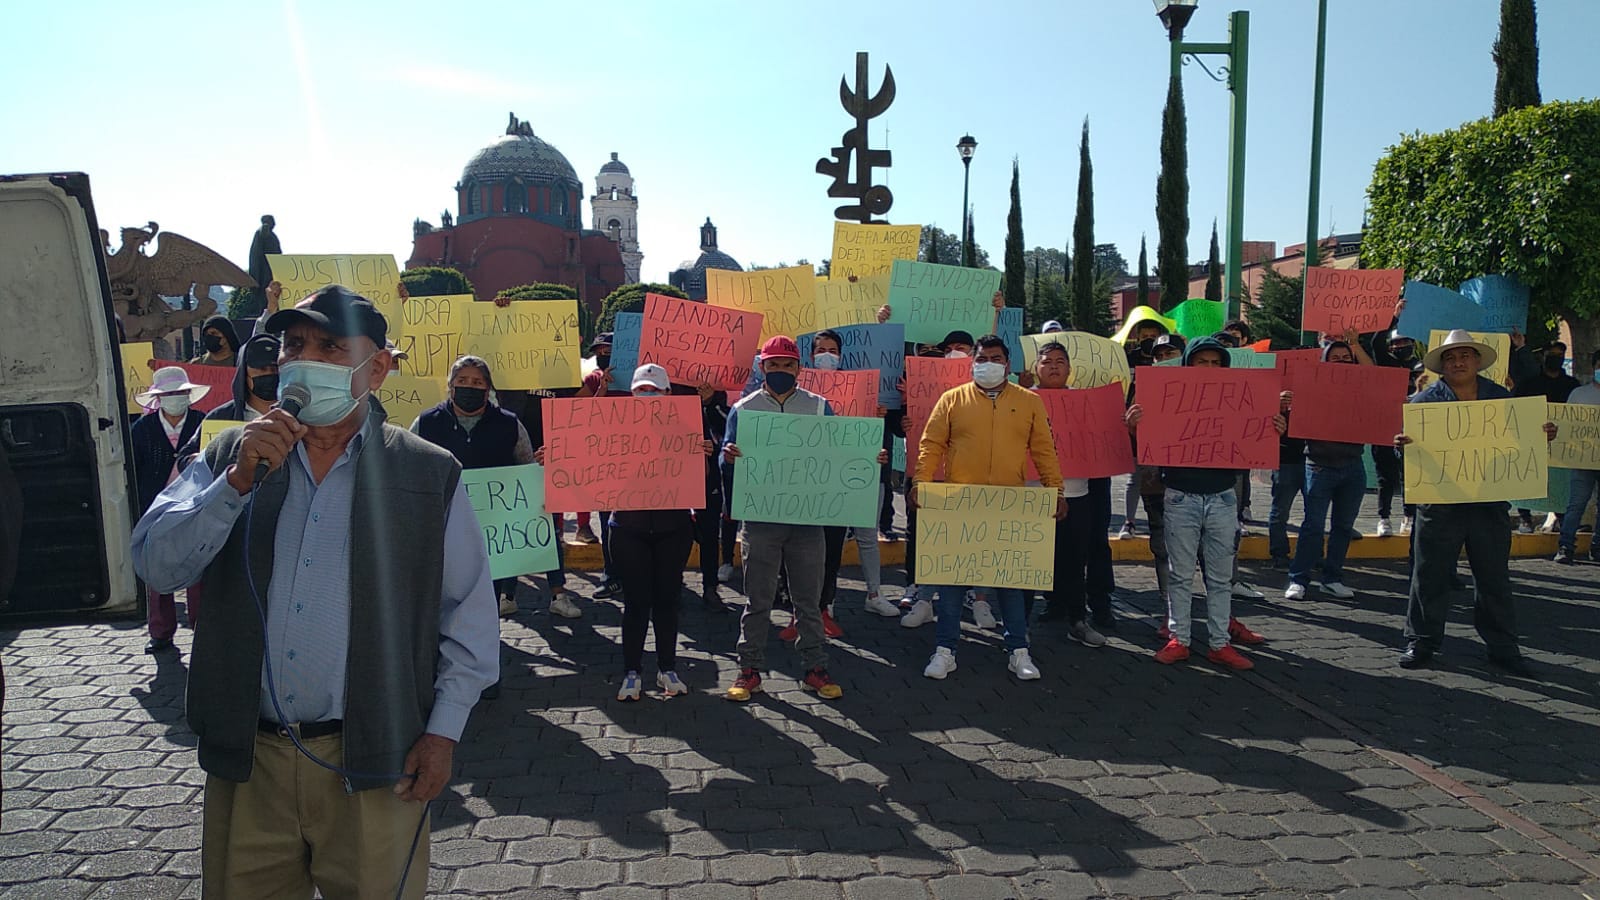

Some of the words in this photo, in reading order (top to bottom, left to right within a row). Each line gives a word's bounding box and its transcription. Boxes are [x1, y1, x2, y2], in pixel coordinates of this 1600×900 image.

[838, 246, 865, 261] DEJA
[289, 256, 393, 286] JUSTICIA
[893, 261, 995, 297] LEANDRA
[1308, 270, 1393, 293] JURIDICOS
[712, 273, 801, 307] FUERA
[1310, 291, 1320, 307] Y
[467, 308, 555, 337] LEANDRA
[648, 296, 744, 336] LEANDRA
[909, 296, 990, 323] RATERA
[654, 327, 736, 358] RESPETA
[1160, 380, 1255, 415] FUERA
[551, 399, 680, 431] LEANDRA
[1179, 416, 1224, 442] LOS
[1242, 415, 1273, 442] DE
[1408, 403, 1520, 442] FUERA
[750, 415, 882, 449] TESORERO
[550, 437, 577, 464] EL
[584, 433, 651, 458] PUEBLO
[551, 461, 630, 489] QUIERE
[743, 456, 832, 486] RATERO
[1412, 446, 1539, 488] LEANDRA
[922, 483, 1052, 517] LEANDRA
[921, 519, 948, 546] YA
[959, 520, 988, 545] NO
[997, 519, 1045, 544] ERES
[919, 552, 977, 578] DIGNA
[981, 549, 1033, 569] ENTRE
[954, 567, 984, 584] LAS
